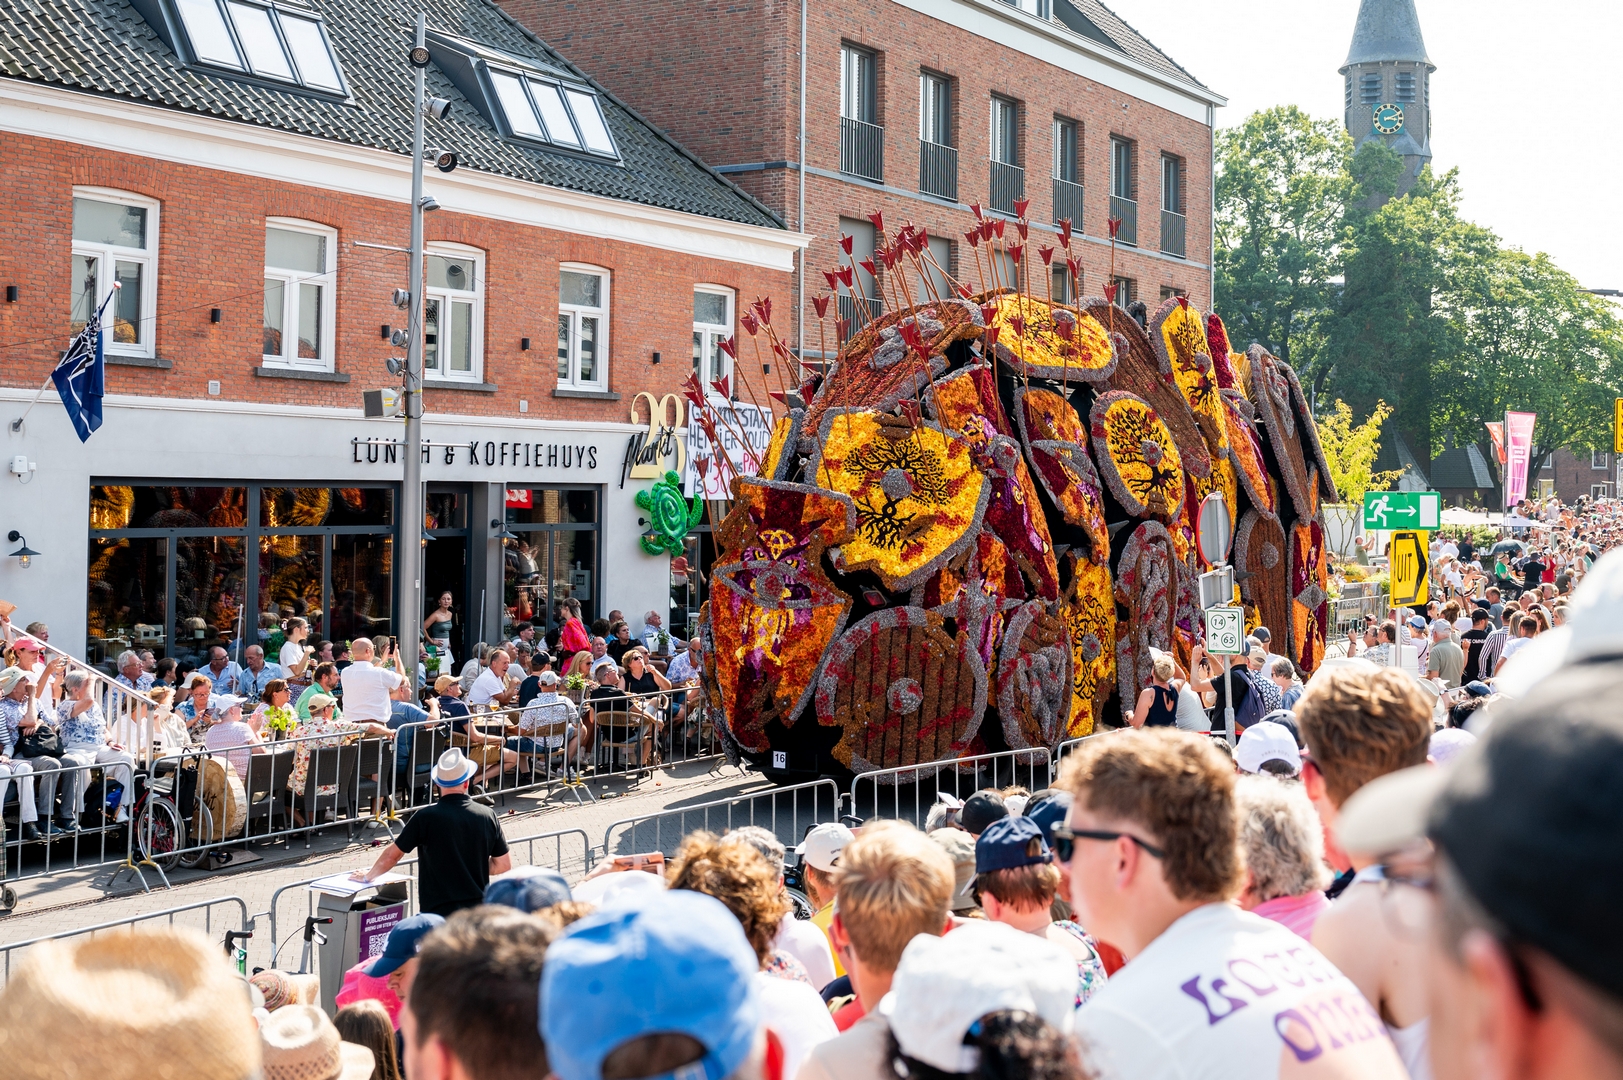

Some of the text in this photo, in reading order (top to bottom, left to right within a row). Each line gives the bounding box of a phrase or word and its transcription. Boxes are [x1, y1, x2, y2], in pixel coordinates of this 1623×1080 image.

[630, 392, 686, 478] 28
[353, 437, 597, 469] LUNH & KOFFIEHUYS
[620, 426, 674, 489] Markt
[1397, 553, 1412, 582] UIT
[1223, 635, 1234, 644] 65
[775, 753, 785, 763] 16
